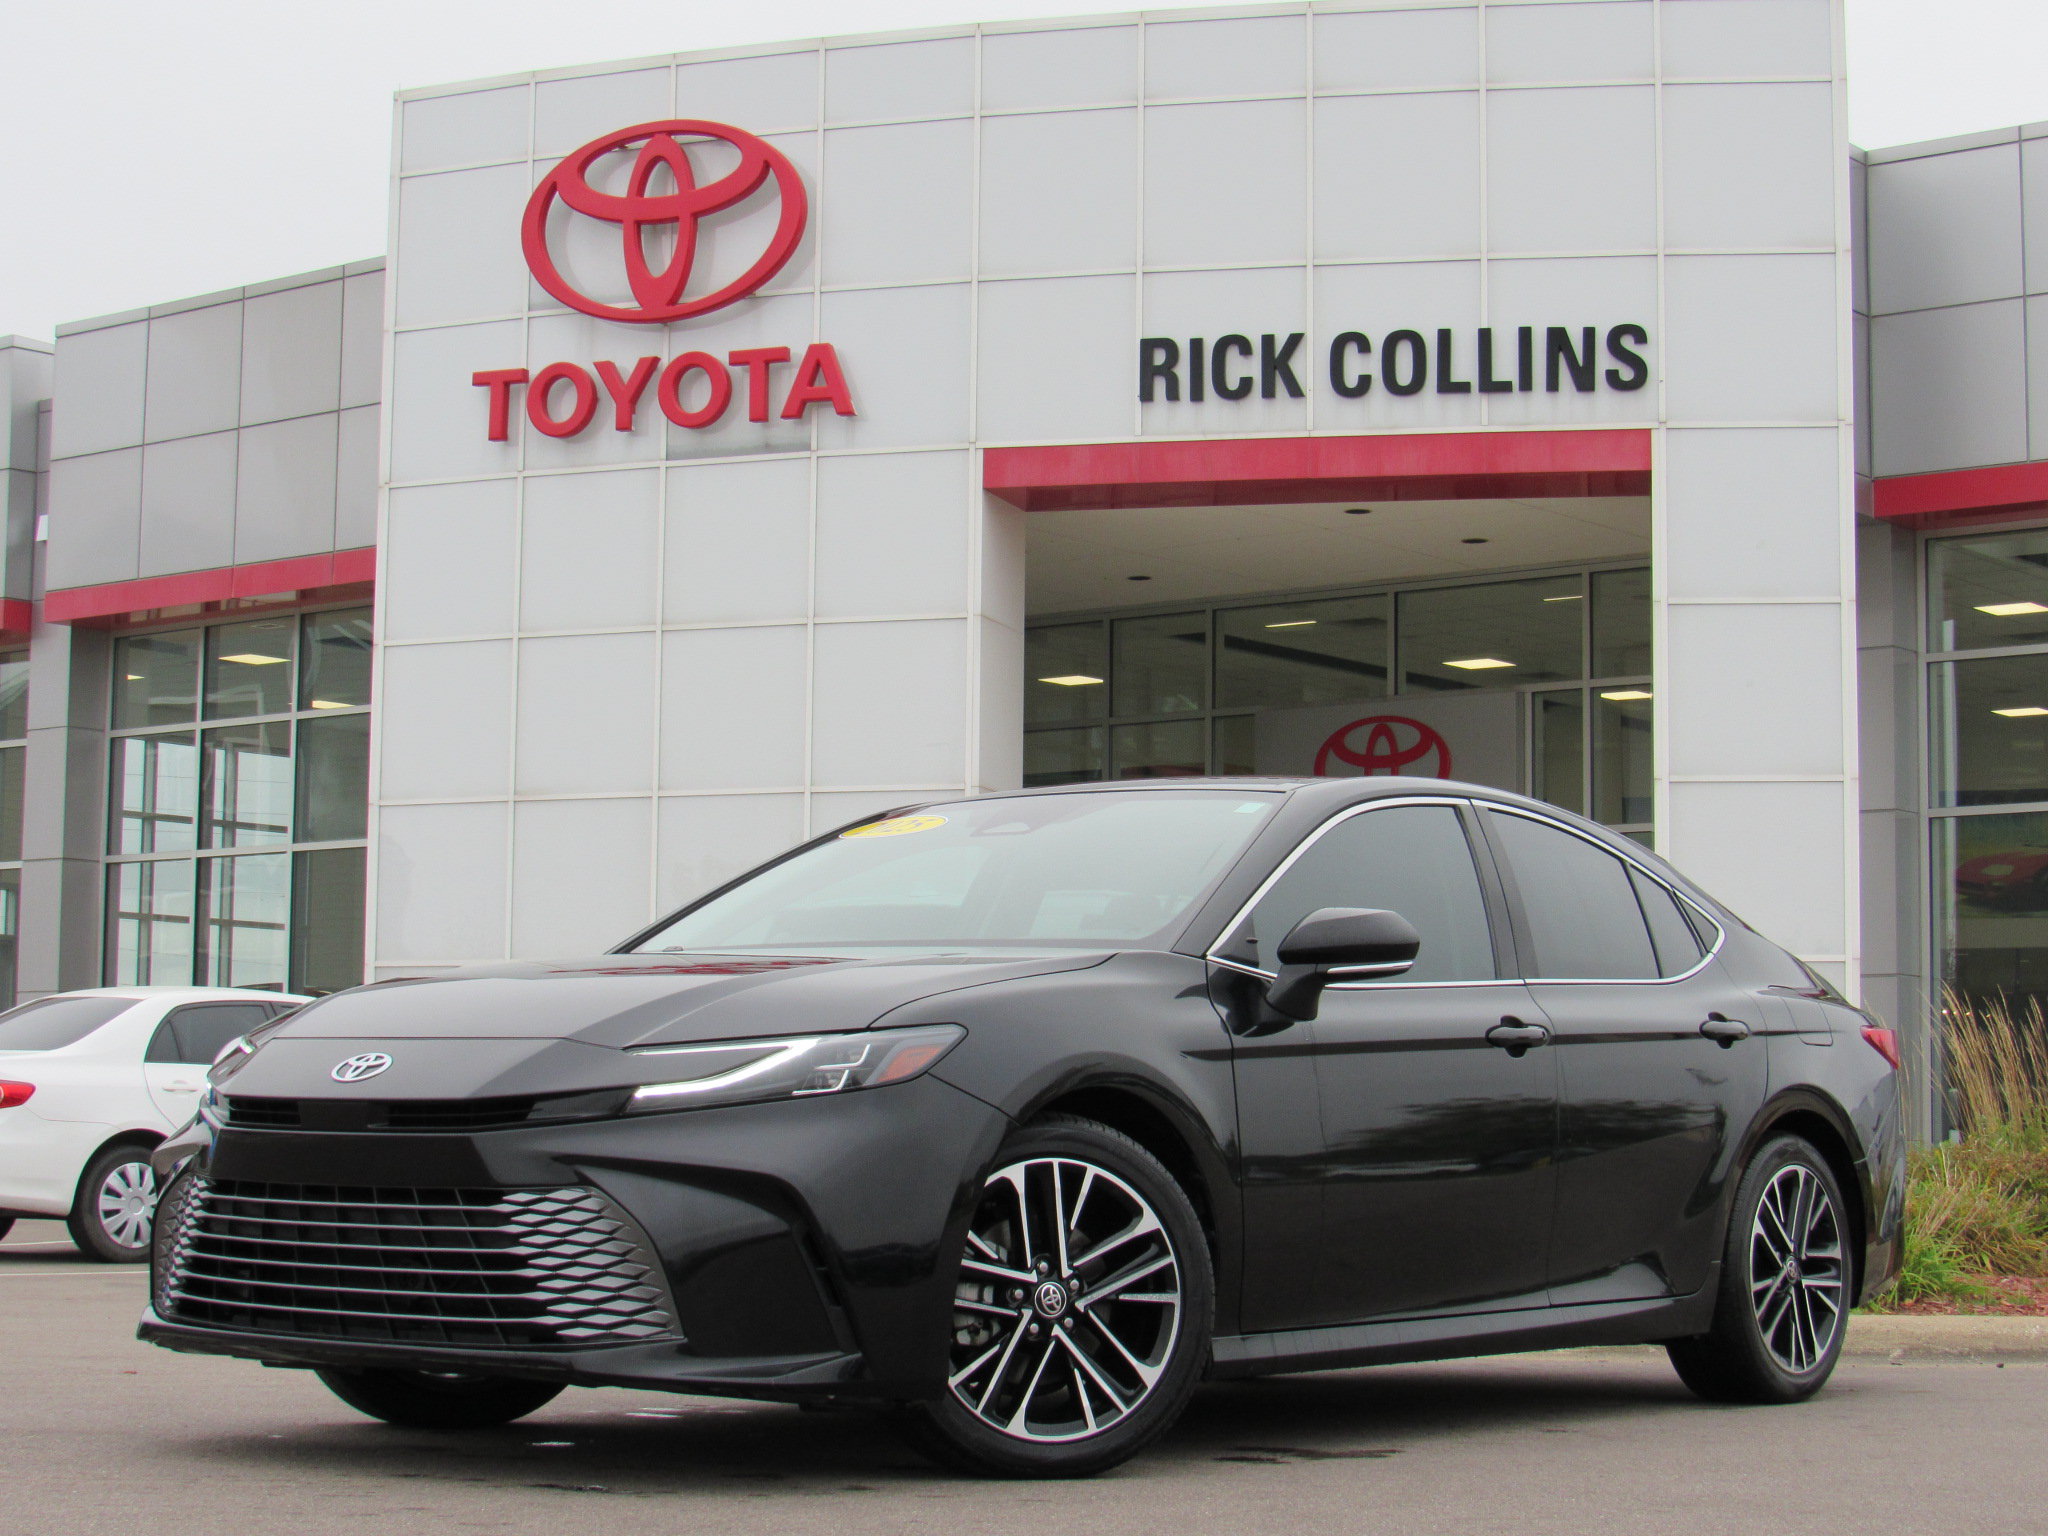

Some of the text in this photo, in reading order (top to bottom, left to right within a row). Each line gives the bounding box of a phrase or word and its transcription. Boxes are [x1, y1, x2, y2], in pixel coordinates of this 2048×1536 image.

[473, 343, 855, 441] TOYOTA
[1140, 324, 1647, 403] RICK COLLINS
